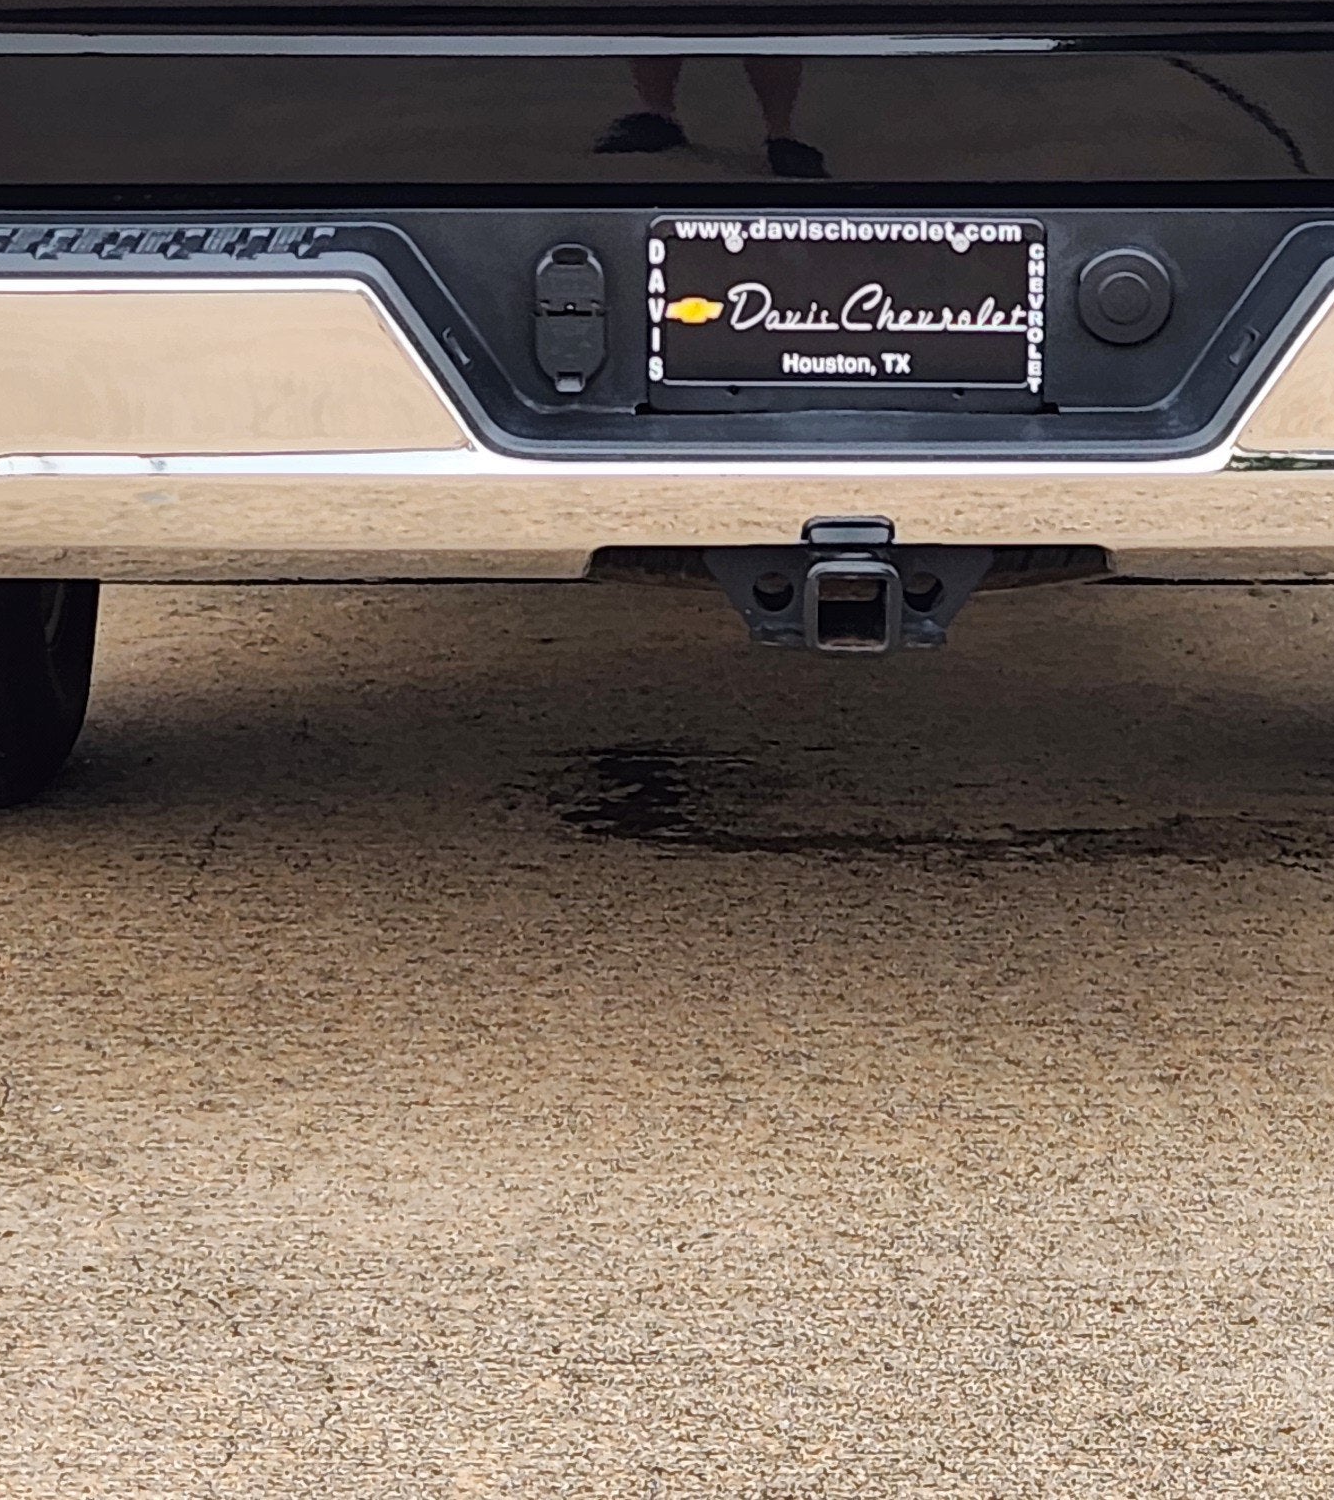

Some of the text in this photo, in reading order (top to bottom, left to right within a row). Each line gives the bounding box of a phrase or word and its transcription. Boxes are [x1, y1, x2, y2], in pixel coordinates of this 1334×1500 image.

[674, 218, 1023, 244] www.davischevroletcom
[648, 238, 665, 382] DAVIS
[727, 283, 1027, 332] Davis Chevrolet
[1027, 243, 1046, 393] CHEVROLET
[782, 352, 912, 377] Houston, TX
